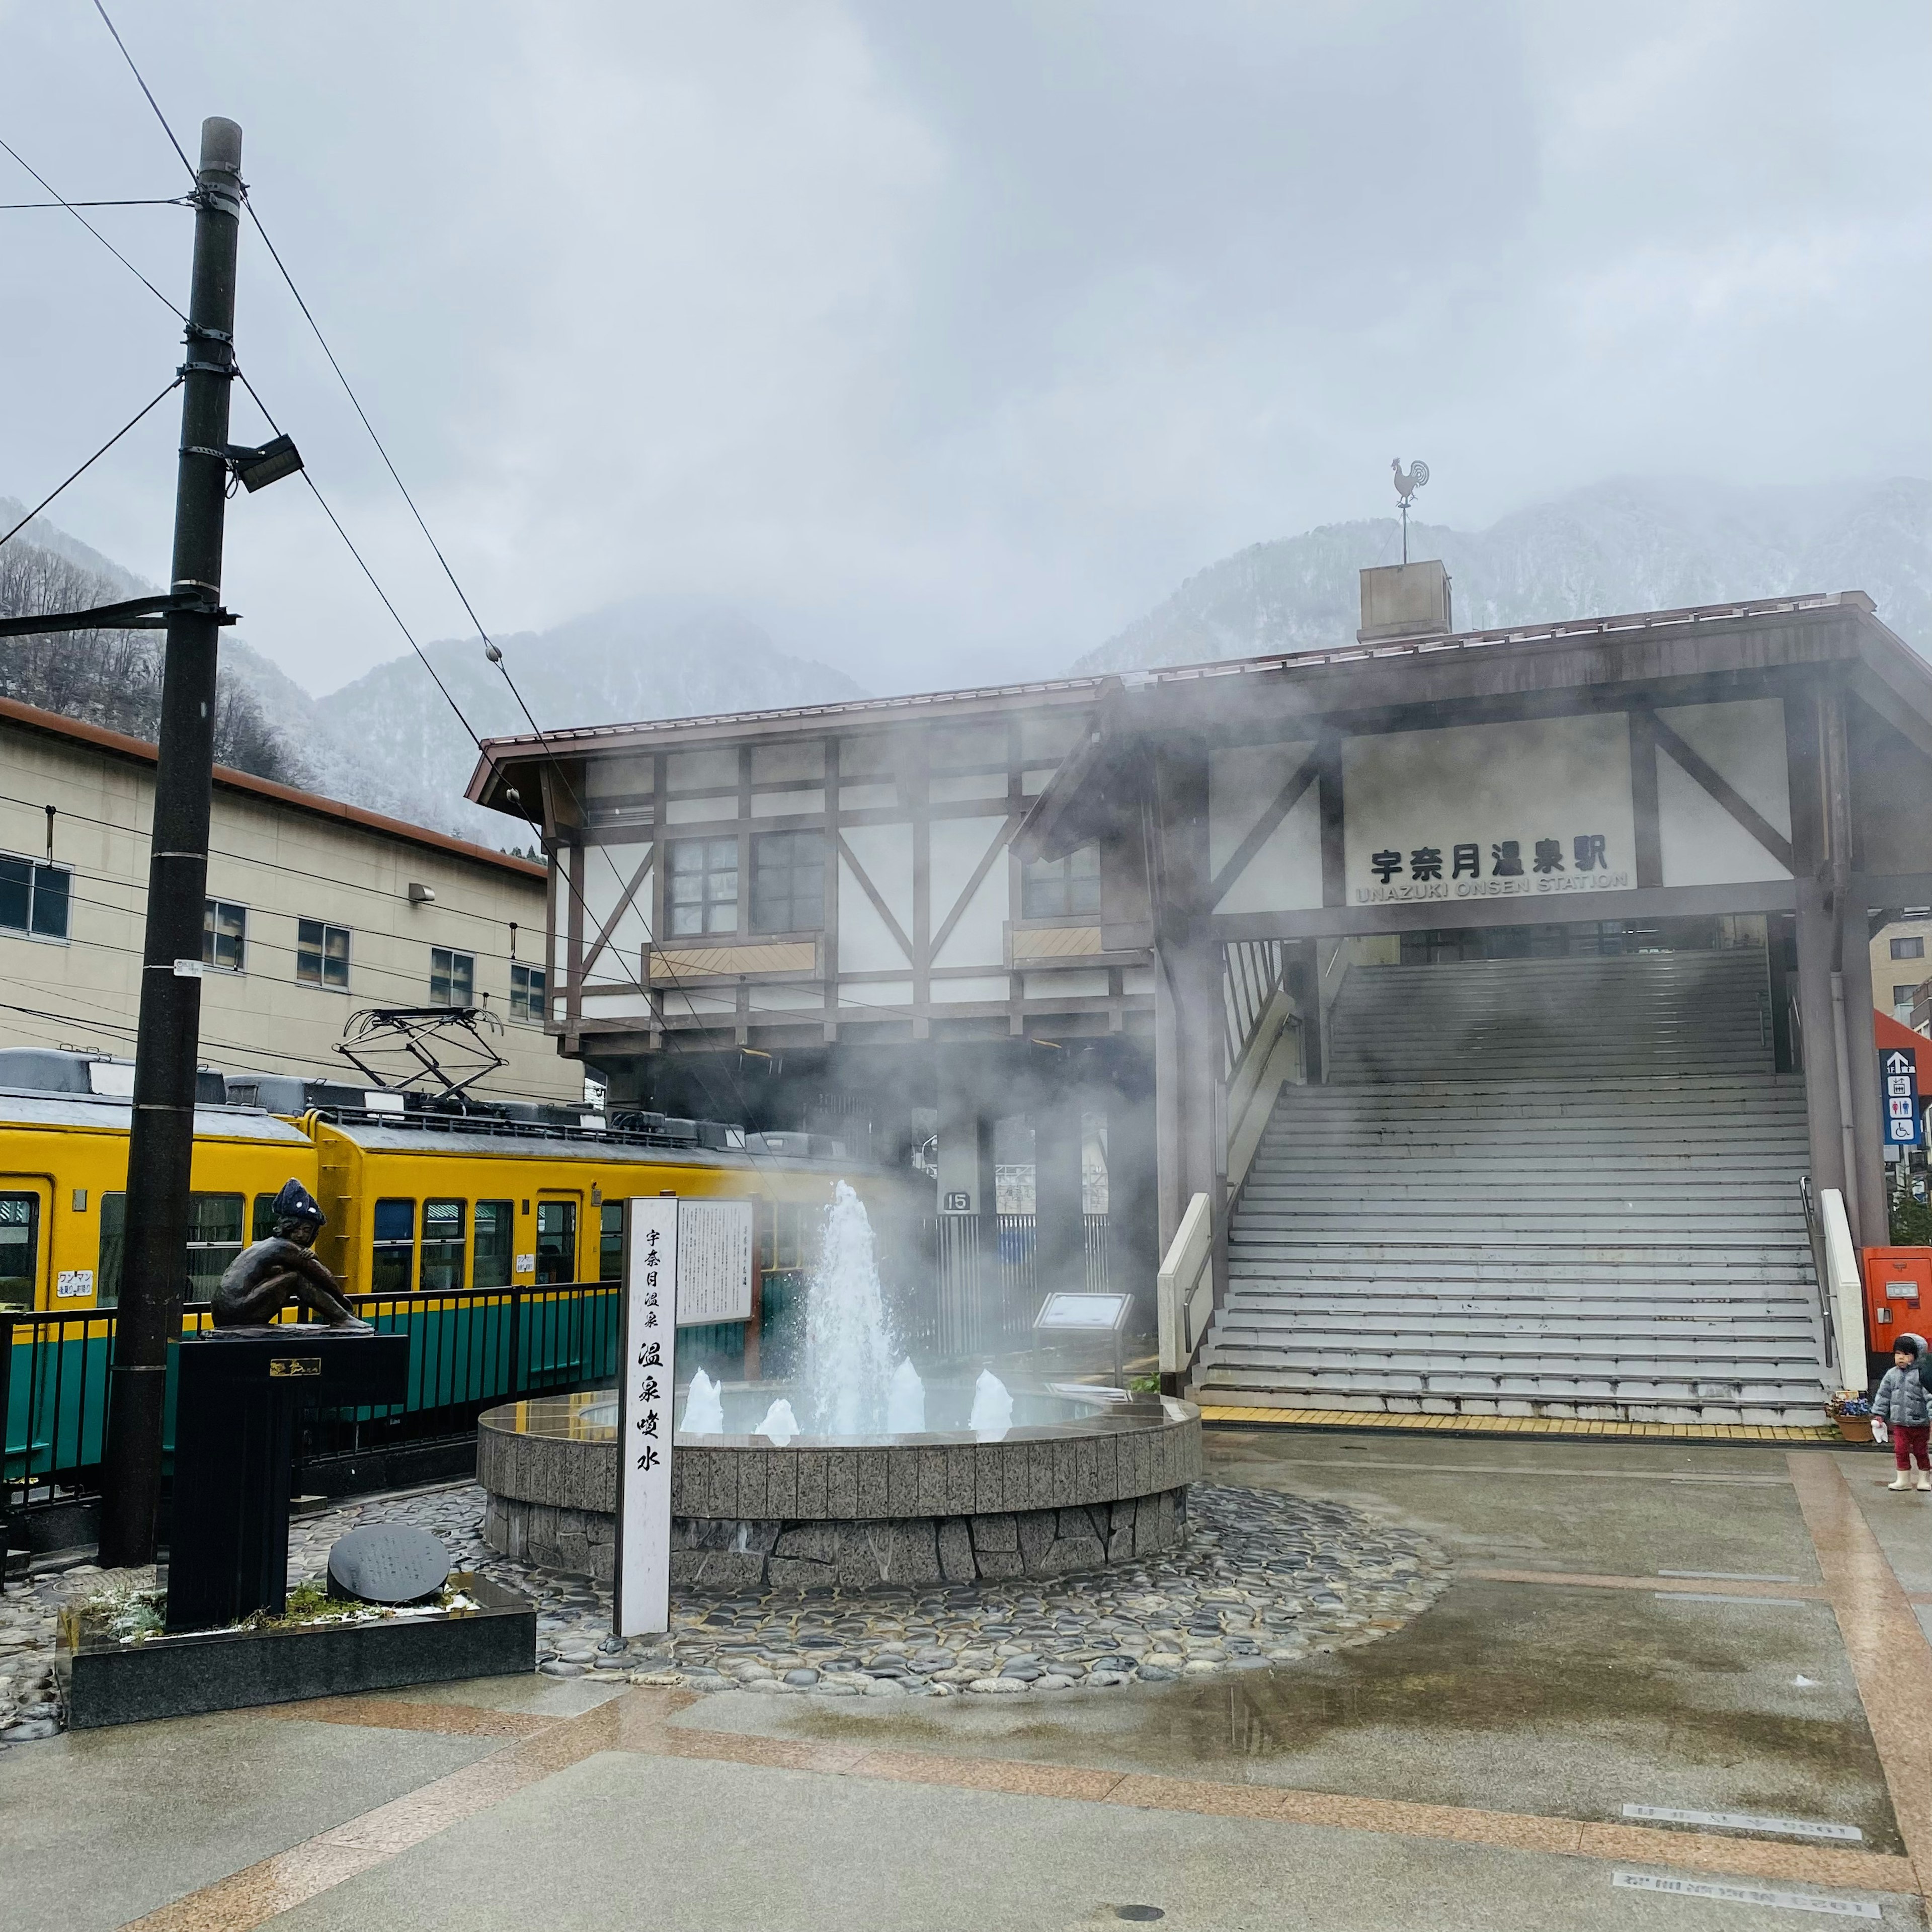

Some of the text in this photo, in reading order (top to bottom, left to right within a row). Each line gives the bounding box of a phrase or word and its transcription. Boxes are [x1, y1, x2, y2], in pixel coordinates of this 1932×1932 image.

[1372, 835, 1607, 884] 宇奈月温泉駅
[1356, 872, 1628, 903] UNAZUKI ONSEN STATION
[949, 1194, 965, 1209] 15
[59, 1273, 91, 1282] ワンマン
[636, 1229, 664, 1472] 宇奈月温泉 温泉噴水
